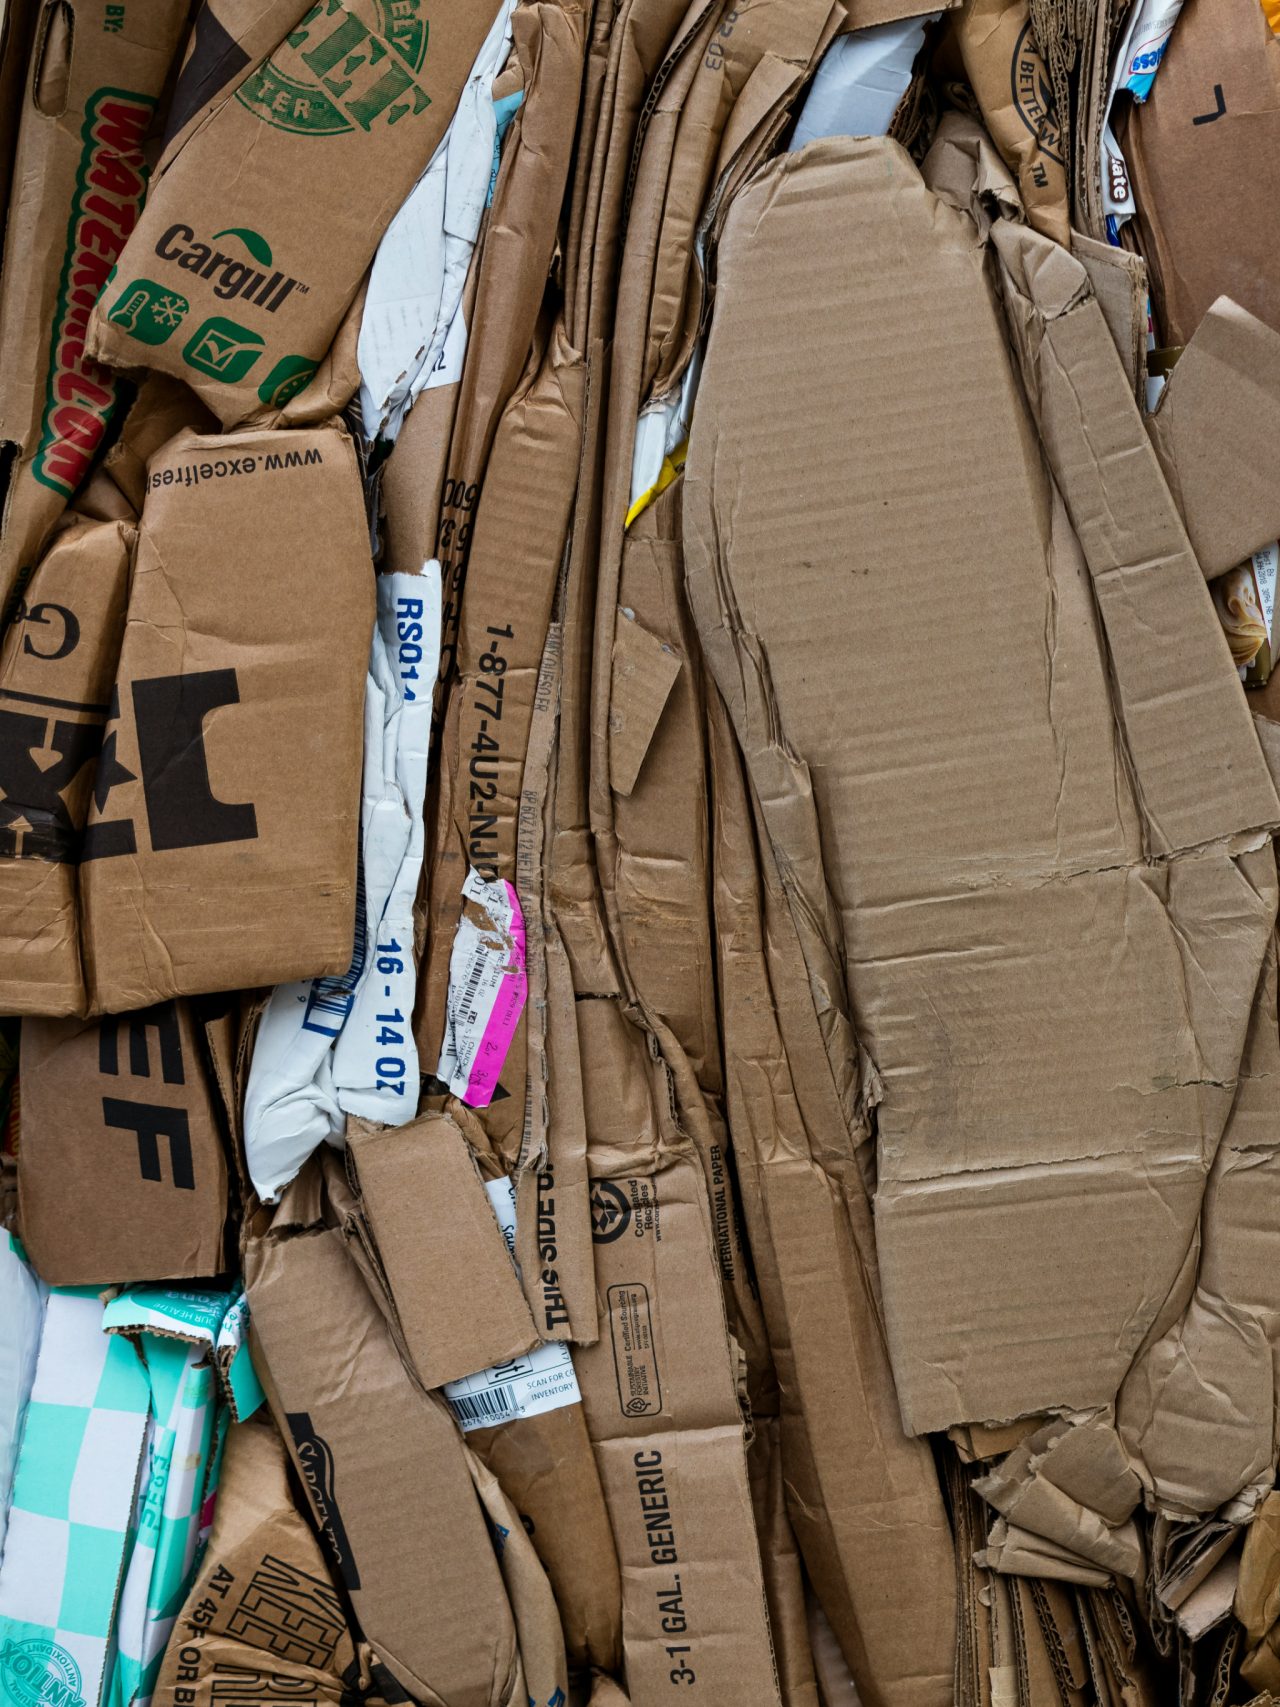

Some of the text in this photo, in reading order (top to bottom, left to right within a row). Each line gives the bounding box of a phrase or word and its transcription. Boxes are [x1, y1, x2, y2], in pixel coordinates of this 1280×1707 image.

[104, 5, 125, 33] BY:
[1020, 60, 1046, 129] BETTER
[155, 224, 296, 313] Cargill
[148, 448, 323, 494] www.excelfres
[518, 852, 534, 872] NET
[377, 938, 404, 974] 16
[375, 1008, 405, 1046] 14
[628, 1179, 645, 1238] Corrugated
[640, 1184, 654, 1231] Recycles
[710, 1144, 735, 1281] INTERNATIONAL PAPER
[541, 1270, 570, 1331] THIS
[618, 1290, 632, 1352] Certified Sourcing
[527, 1377, 547, 1390] SCAN
[548, 1372, 564, 1382] FOR
[531, 1382, 574, 1401] INVENTORY
[208, 1564, 236, 1599] AT
[634, 1450, 696, 1686] 3-1 GAL. GENERIC
[227, 1554, 346, 1669] KEE
[27, 1644, 77, 1687] ANTIOXIDANT
[177, 1648, 202, 1682] OR
